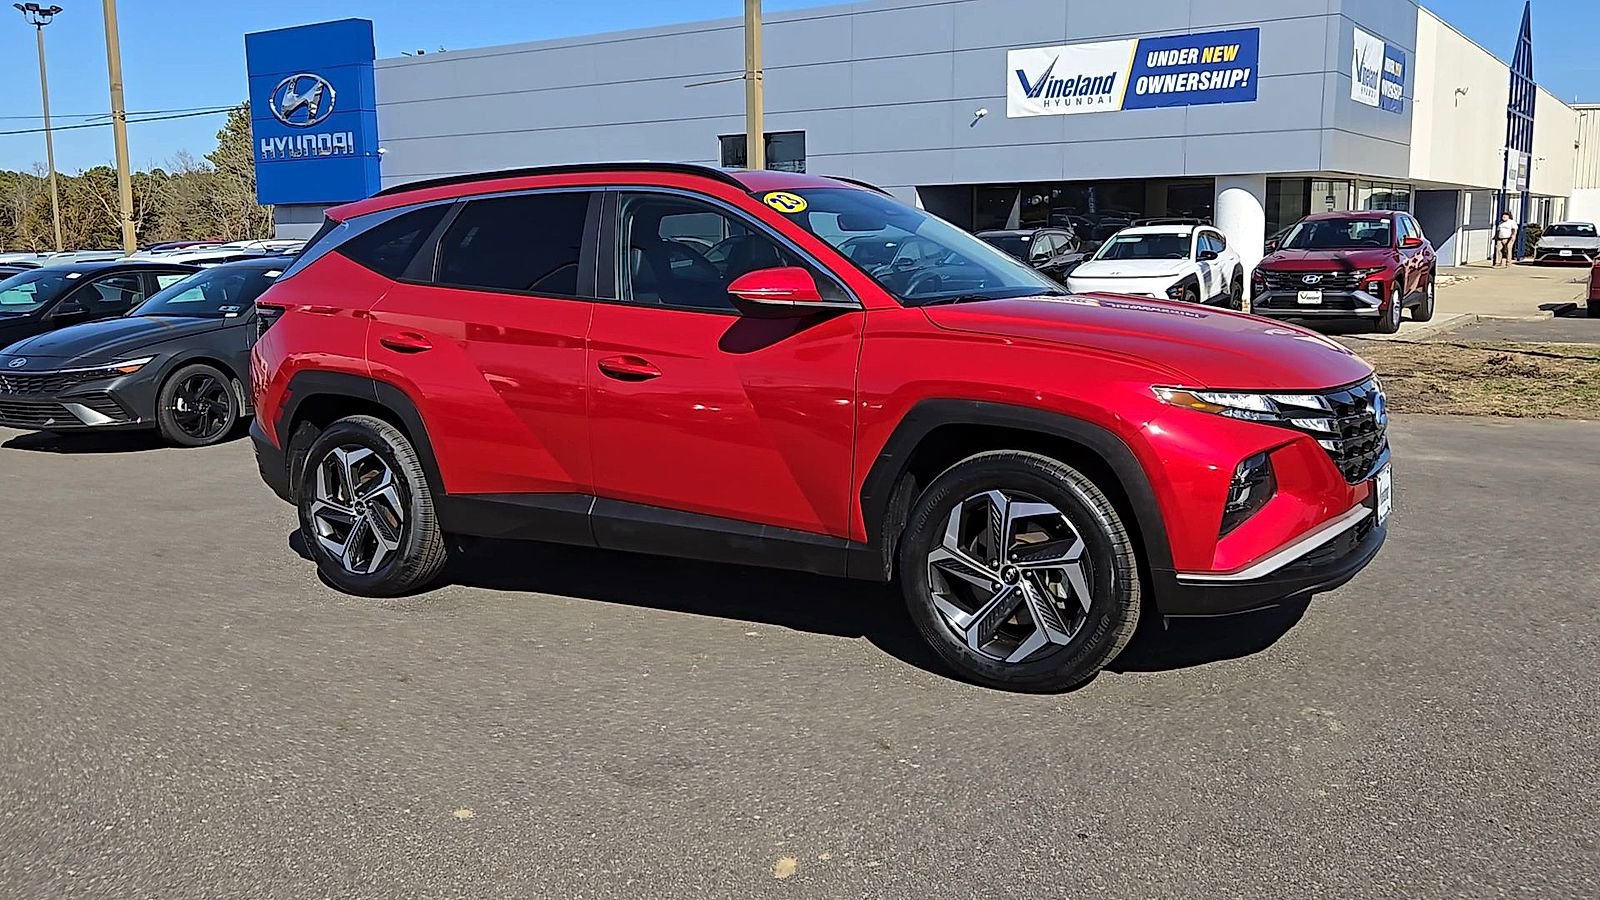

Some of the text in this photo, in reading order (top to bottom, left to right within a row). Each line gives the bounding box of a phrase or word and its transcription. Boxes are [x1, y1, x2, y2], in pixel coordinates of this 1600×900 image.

[1147, 44, 1240, 68] UNDER NEW
[1015, 54, 1117, 99] Vineland
[1135, 68, 1250, 95] OWNERSHIP!
[1044, 96, 1112, 108] HYUNDAI
[260, 131, 354, 160] HYUNDAI
[769, 194, 801, 210] 23
